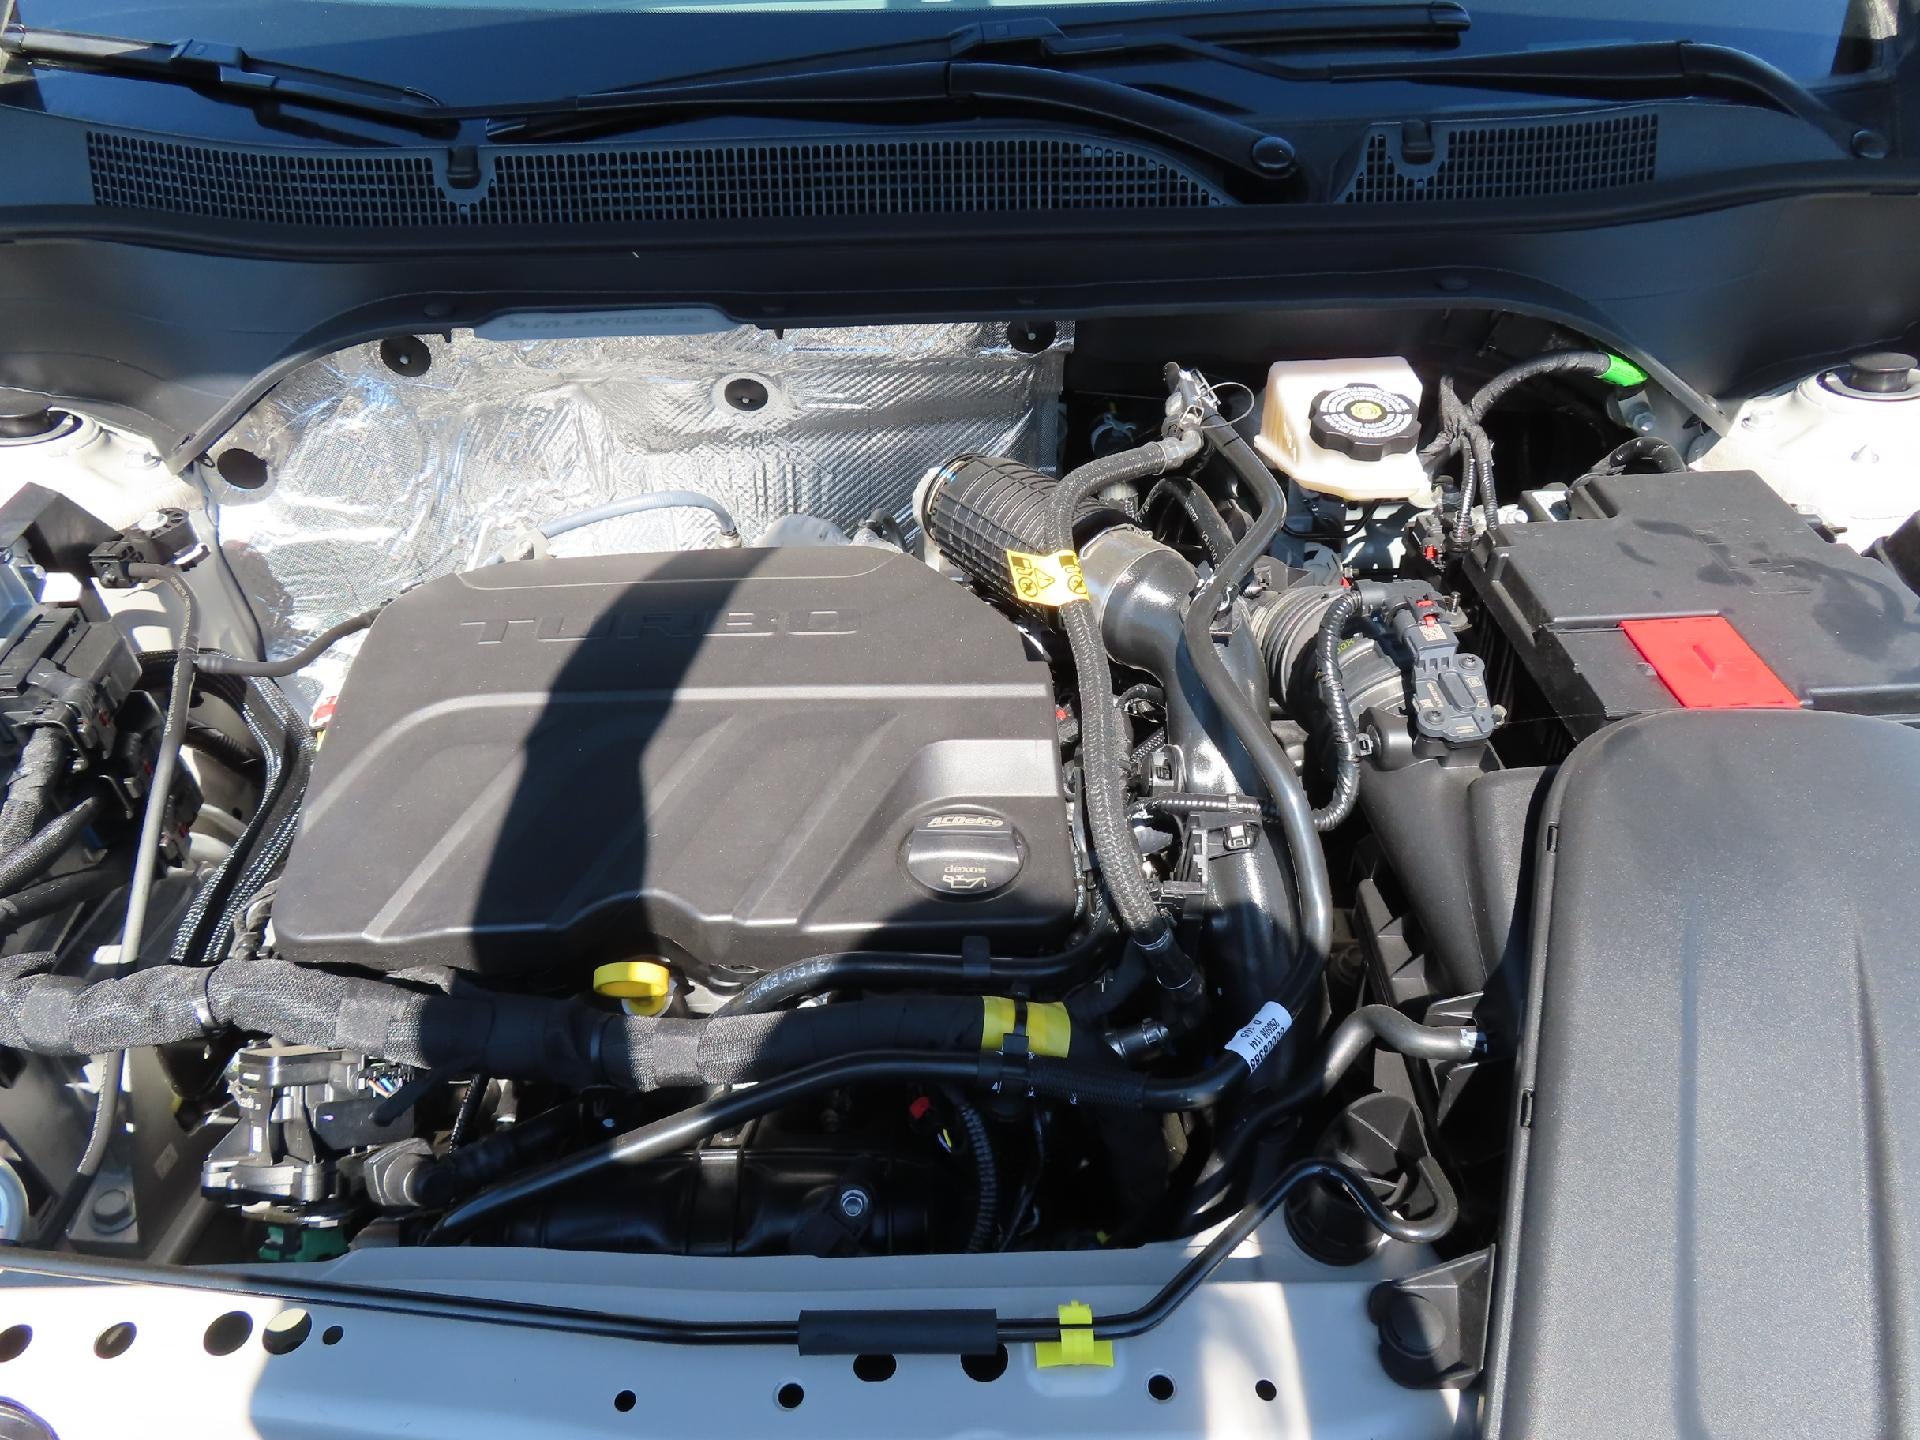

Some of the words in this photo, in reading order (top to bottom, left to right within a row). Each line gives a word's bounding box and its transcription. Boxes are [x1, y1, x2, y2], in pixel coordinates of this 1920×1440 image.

[459, 607, 862, 645] TURBO
[927, 815, 1004, 828] ACDelco
[944, 864, 987, 873] dexos
